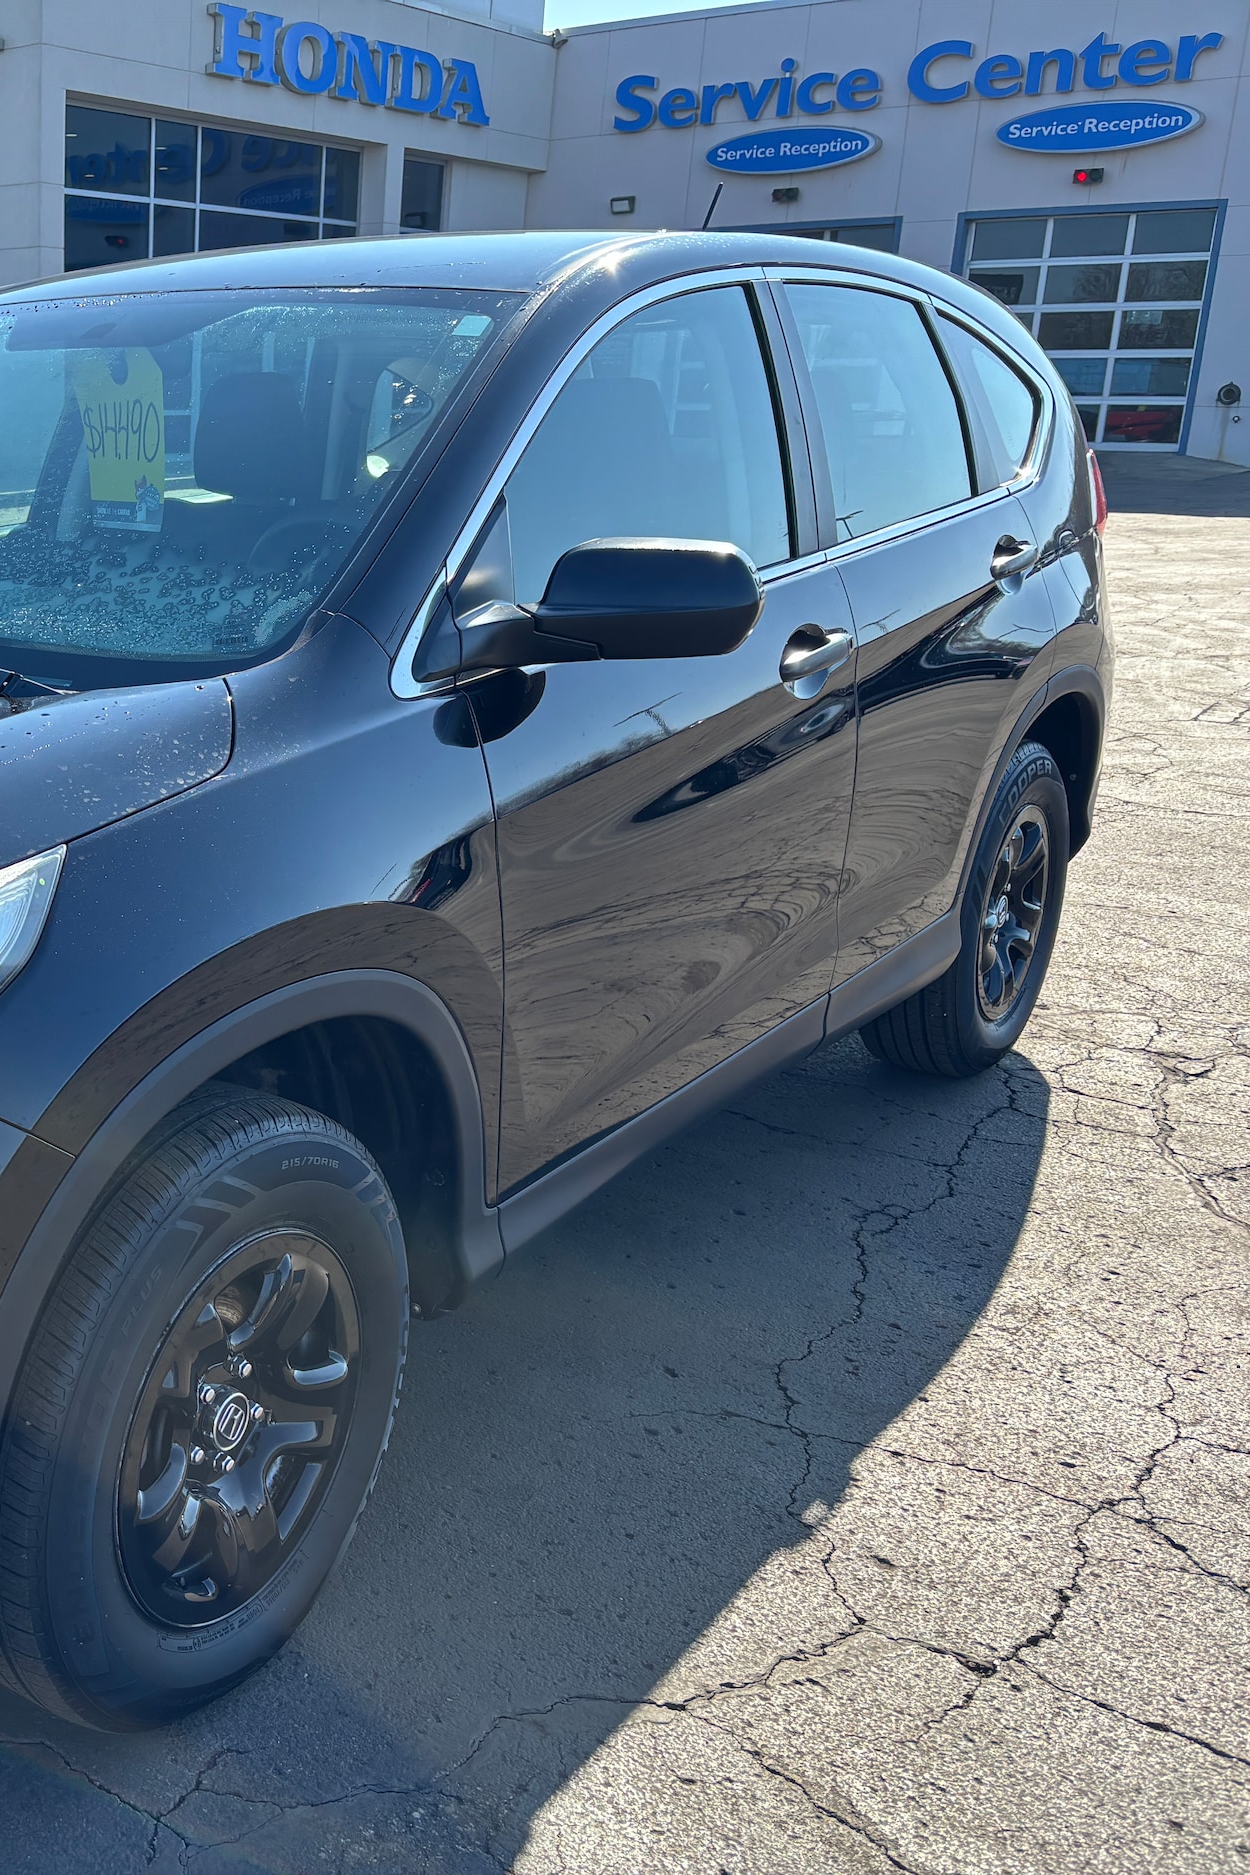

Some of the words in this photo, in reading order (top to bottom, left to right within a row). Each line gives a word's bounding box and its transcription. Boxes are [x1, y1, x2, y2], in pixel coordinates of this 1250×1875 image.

[205, 3, 490, 126] HONDA
[613, 56, 883, 133] Service
[907, 31, 1225, 104] Center
[716, 145, 775, 161] Service
[779, 138, 862, 157] Reception
[1008, 121, 1078, 139] Service
[1083, 112, 1183, 135] Reception
[999, 759, 1053, 827] COOPER
[281, 1156, 340, 1170] 215/70R16
[120, 1263, 164, 1338] PLUS
